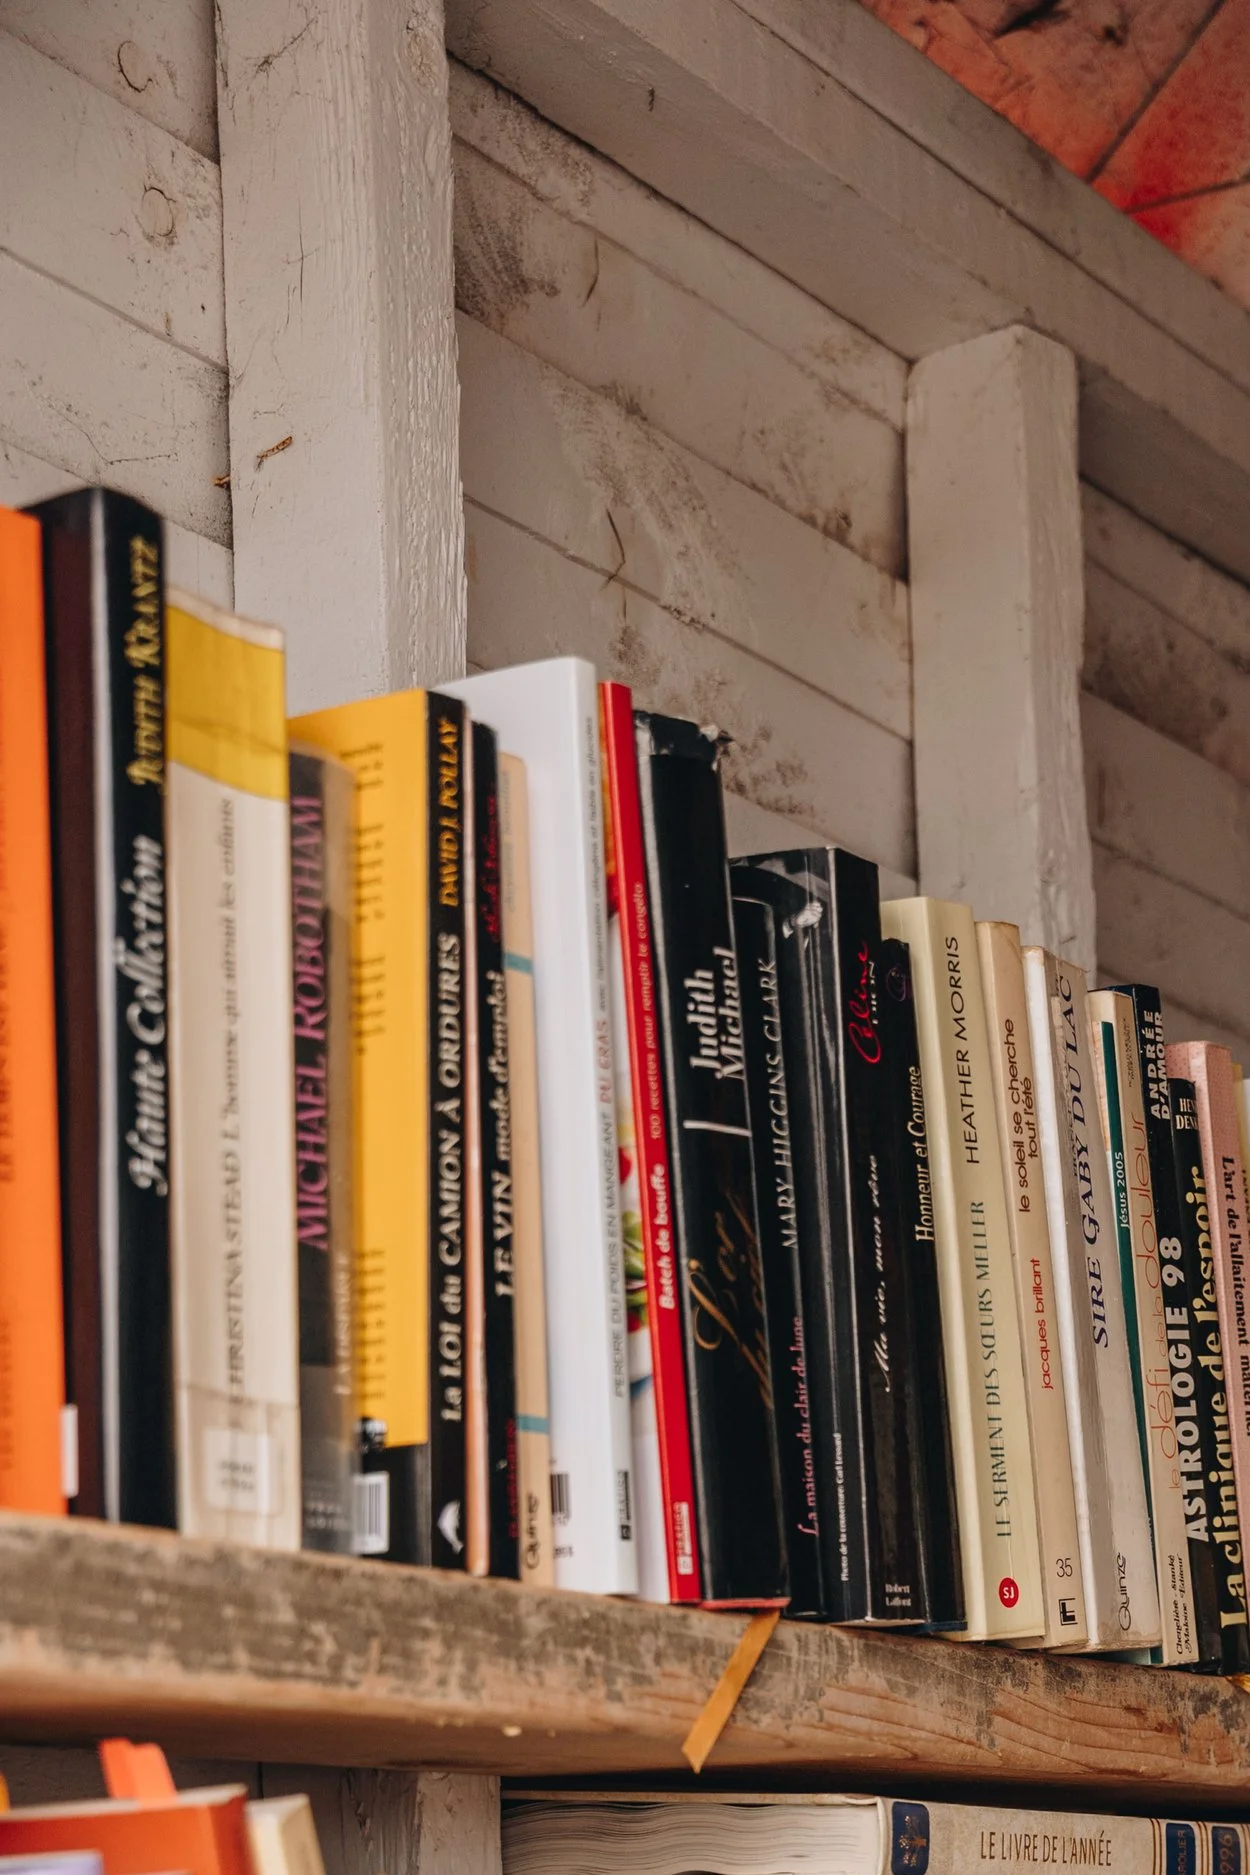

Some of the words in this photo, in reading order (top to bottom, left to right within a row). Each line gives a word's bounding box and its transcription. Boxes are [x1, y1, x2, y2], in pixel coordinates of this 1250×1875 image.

[112, 835, 165, 1045] Collection
[292, 797, 326, 1039] ROBOTHAM
[437, 932, 460, 1088] ORDURES
[713, 946, 745, 1081] Michael
[758, 956, 782, 1041] CLARK
[945, 936, 968, 1041] MORRIS
[1060, 975, 1079, 1055] LAC
[488, 971, 508, 1083] d'emploi
[684, 968, 722, 1078] Judith
[1003, 1018, 1021, 1105] cherche
[1067, 1063, 1086, 1125] DU
[1142, 1010, 1161, 1119] ANDRÉE
[1153, 1010, 1171, 1120] D'AMOUR
[126, 1049, 168, 1196] Haute
[767, 1053, 792, 1168] HIGGINS
[908, 1066, 926, 1137] Courage
[957, 1049, 979, 1164] HEATHER
[1011, 1112, 1023, 1134] se
[1020, 1076, 1035, 1116] l'été
[295, 1054, 327, 1250] MICHAEL
[913, 1141, 928, 1157] et
[1014, 1140, 1028, 1188] soleil
[1026, 1120, 1039, 1158] tout
[1115, 1151, 1127, 1187] 2005
[438, 1131, 461, 1266] CAMION
[492, 1171, 512, 1240] VIN
[650, 1164, 668, 1225] bouffe
[916, 1165, 936, 1241] Honneur
[1018, 1195, 1030, 1213] le
[1076, 1135, 1100, 1246] GABY
[1117, 1191, 1130, 1228] Jésus
[1222, 1156, 1236, 1200] L'art
[656, 1231, 669, 1251] de
[776, 1177, 799, 1249] MARY
[970, 1201, 990, 1281] MELLER
[1186, 1166, 1216, 1313] l'espoir
[1227, 1208, 1241, 1229] de
[658, 1257, 676, 1309] Batch
[1029, 1258, 1045, 1313] brillant
[1159, 1236, 1186, 1287] 98
[1228, 1233, 1249, 1346] l'allaitement
[440, 1277, 461, 1314] du
[1086, 1257, 1108, 1349] SIRE
[439, 1322, 461, 1378] LOI
[789, 1316, 803, 1351] lune
[1034, 1319, 1053, 1390] jacques
[1197, 1330, 1226, 1381] de
[792, 1357, 805, 1378] de
[983, 1368, 1000, 1405] DES
[440, 1387, 462, 1421] La
[793, 1384, 809, 1418] clair
[795, 1421, 812, 1443] du
[1165, 1306, 1210, 1543] ASTROLOGIE
[800, 1448, 817, 1506] maison
[987, 1414, 1009, 1508] SERMENT
[1203, 1392, 1243, 1564] clinique
[797, 1511, 819, 1536] La
[996, 1515, 1012, 1537] LE
[1056, 1558, 1073, 1578] 35
[1117, 1552, 1131, 1631] Quinze
[1220, 1572, 1248, 1628] La
[980, 1830, 996, 1860] LE
[1001, 1833, 1039, 1862] LIVRE
[1043, 1834, 1058, 1864] DE
[1062, 1830, 1112, 1866] L'ANNÉE
